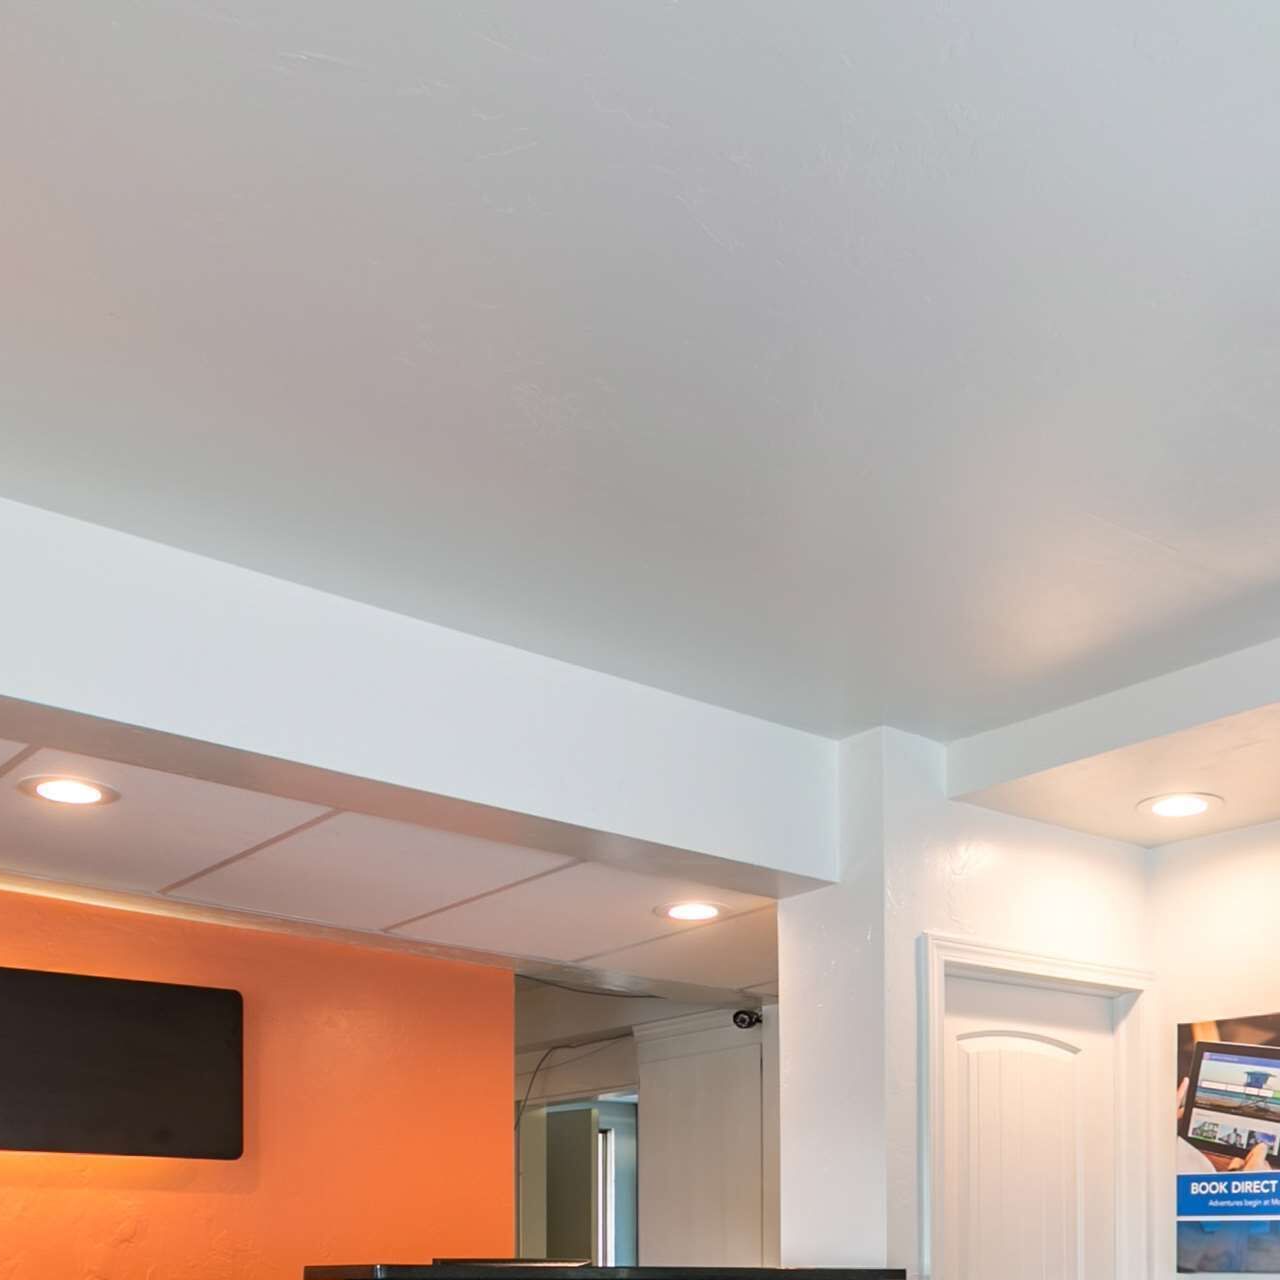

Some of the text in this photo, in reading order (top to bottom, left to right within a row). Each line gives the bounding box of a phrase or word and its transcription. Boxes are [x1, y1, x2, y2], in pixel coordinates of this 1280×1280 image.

[1190, 1182, 1228, 1194] BOOK
[1231, 1180, 1278, 1194] DIRECT
[1244, 1199, 1262, 1208] begin
